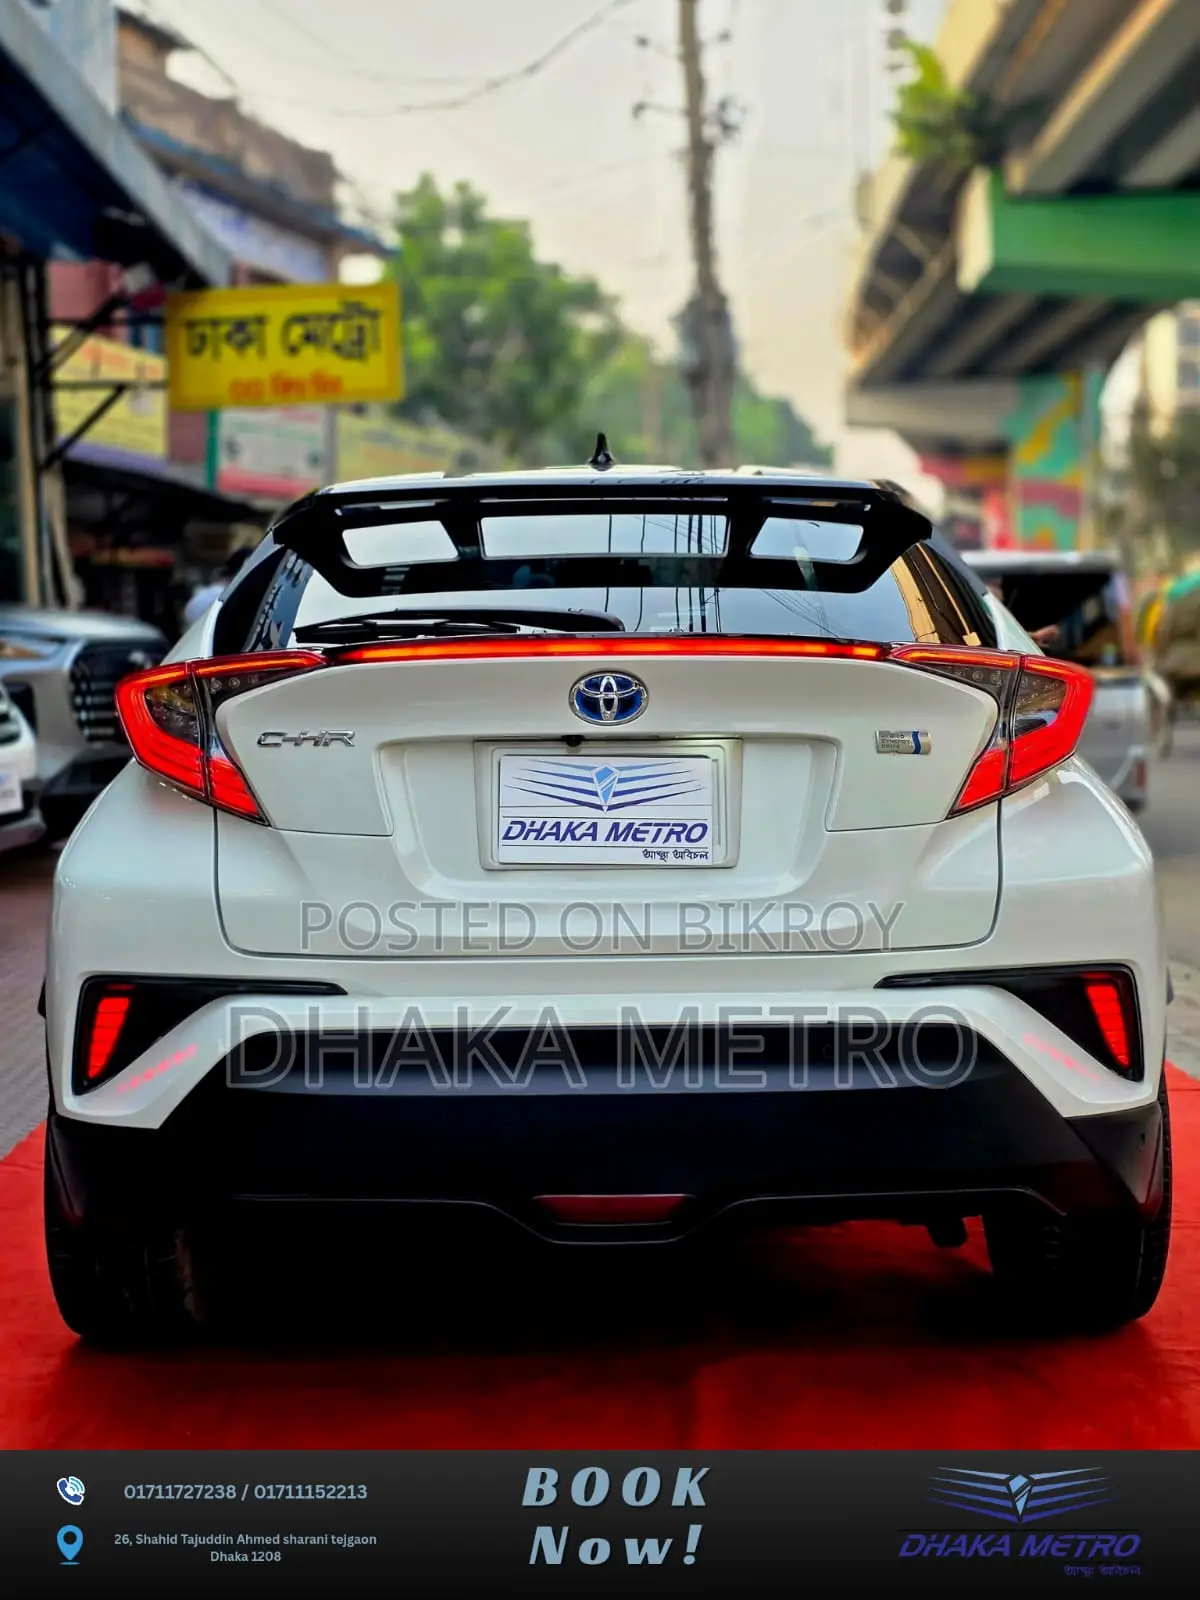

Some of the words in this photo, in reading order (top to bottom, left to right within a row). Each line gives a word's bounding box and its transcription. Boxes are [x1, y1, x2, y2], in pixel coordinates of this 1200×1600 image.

[185, 313, 268, 362] ঢাকা
[257, 730, 355, 748] C-HR
[502, 820, 598, 842] DHAKA
[605, 821, 708, 844] METRO
